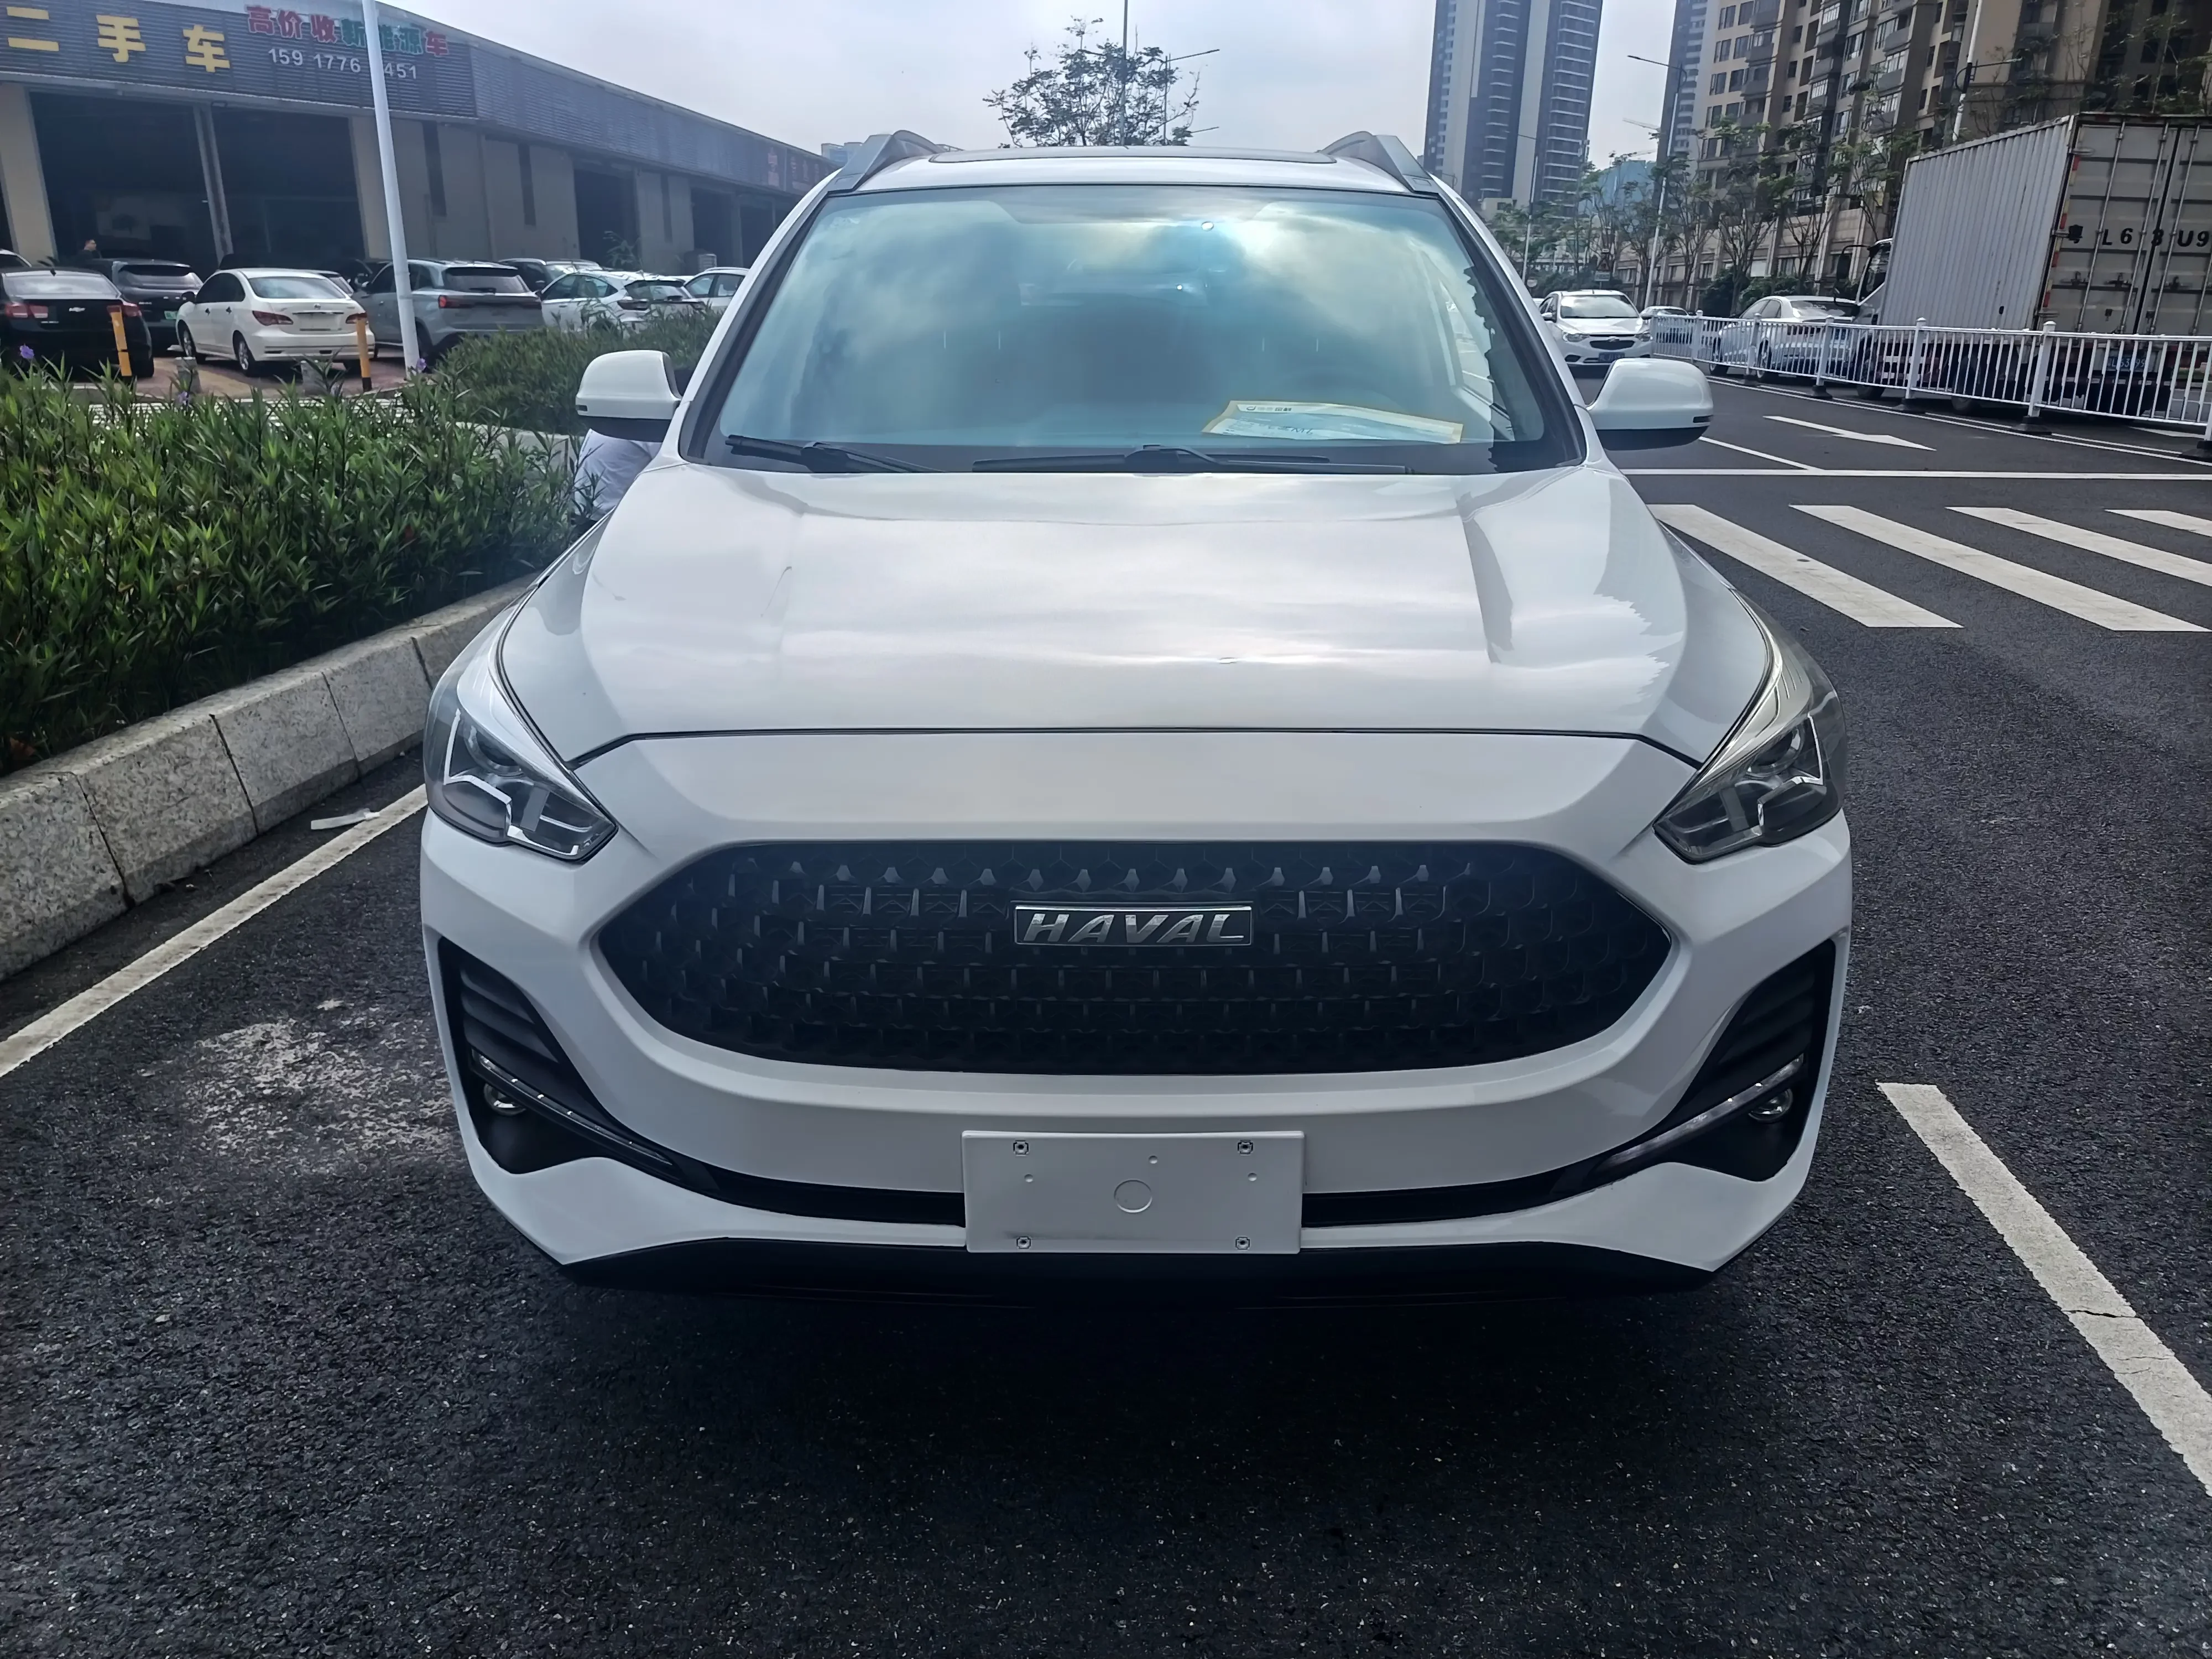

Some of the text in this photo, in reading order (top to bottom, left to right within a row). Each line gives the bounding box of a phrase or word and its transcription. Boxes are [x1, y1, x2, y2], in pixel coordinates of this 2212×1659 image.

[6, 6, 231, 72] 二手车
[269, 49, 416, 80] 159 1776 451
[2070, 227, 2210, 247] L63U9
[1023, 913, 1244, 943] HAVAL
